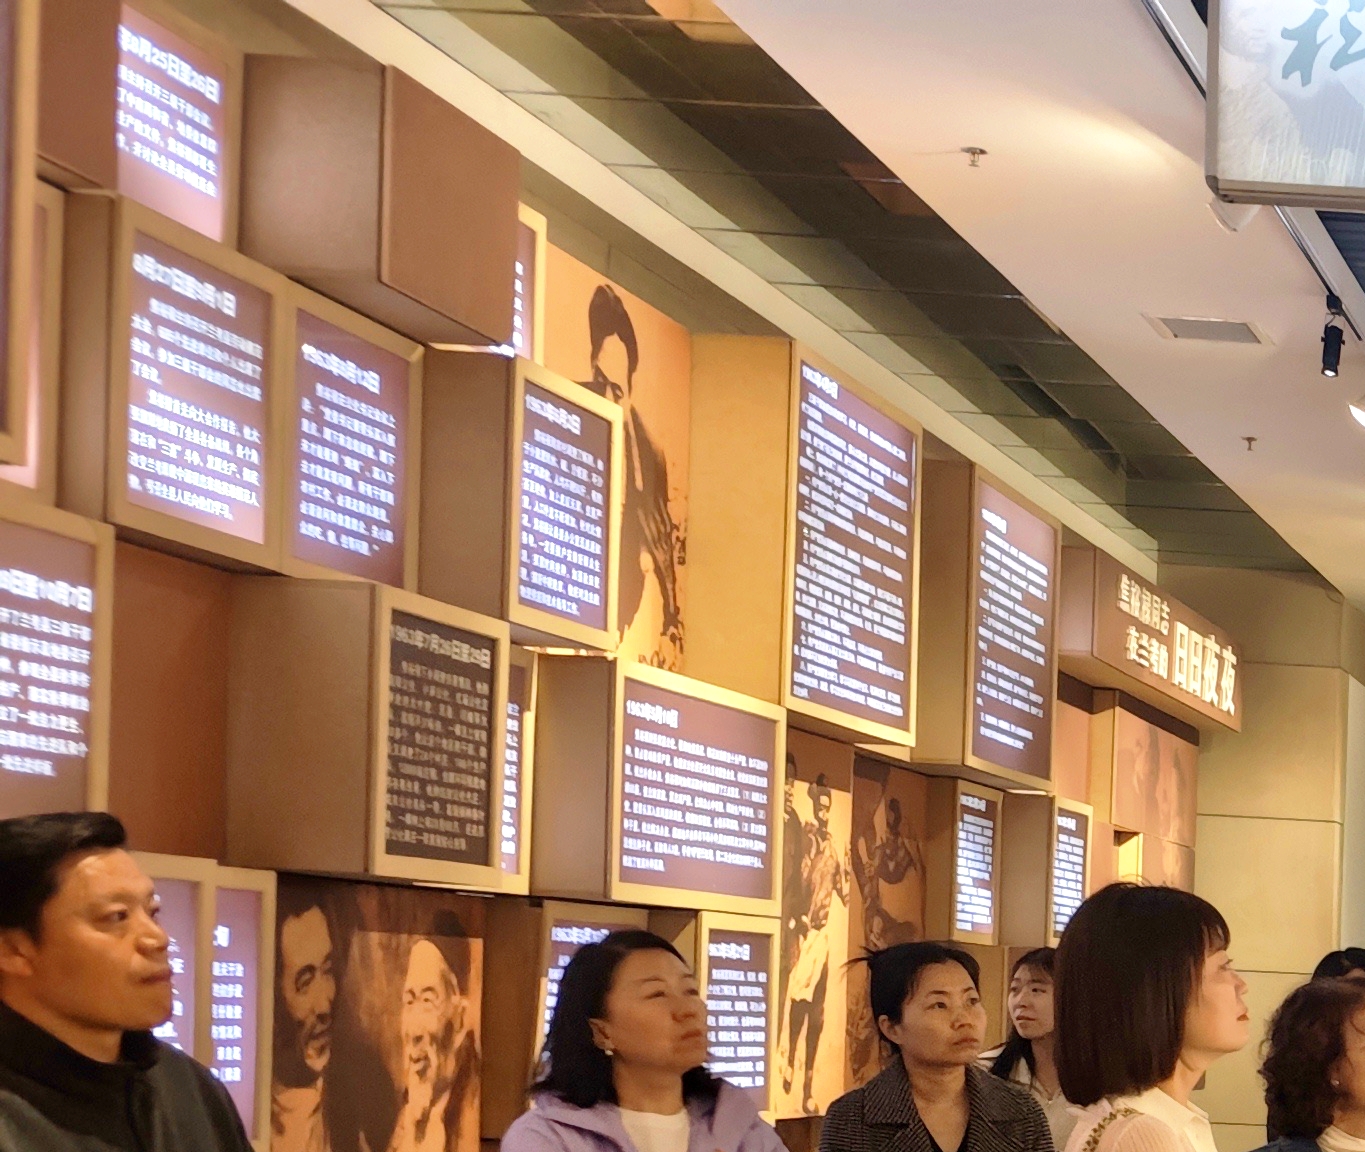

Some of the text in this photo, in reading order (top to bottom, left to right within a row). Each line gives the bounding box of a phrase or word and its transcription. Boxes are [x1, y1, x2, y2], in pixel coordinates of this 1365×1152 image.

[1118, 573, 1171, 636] 焦裕禄同志
[1172, 620, 1237, 717] 日日夜夜
